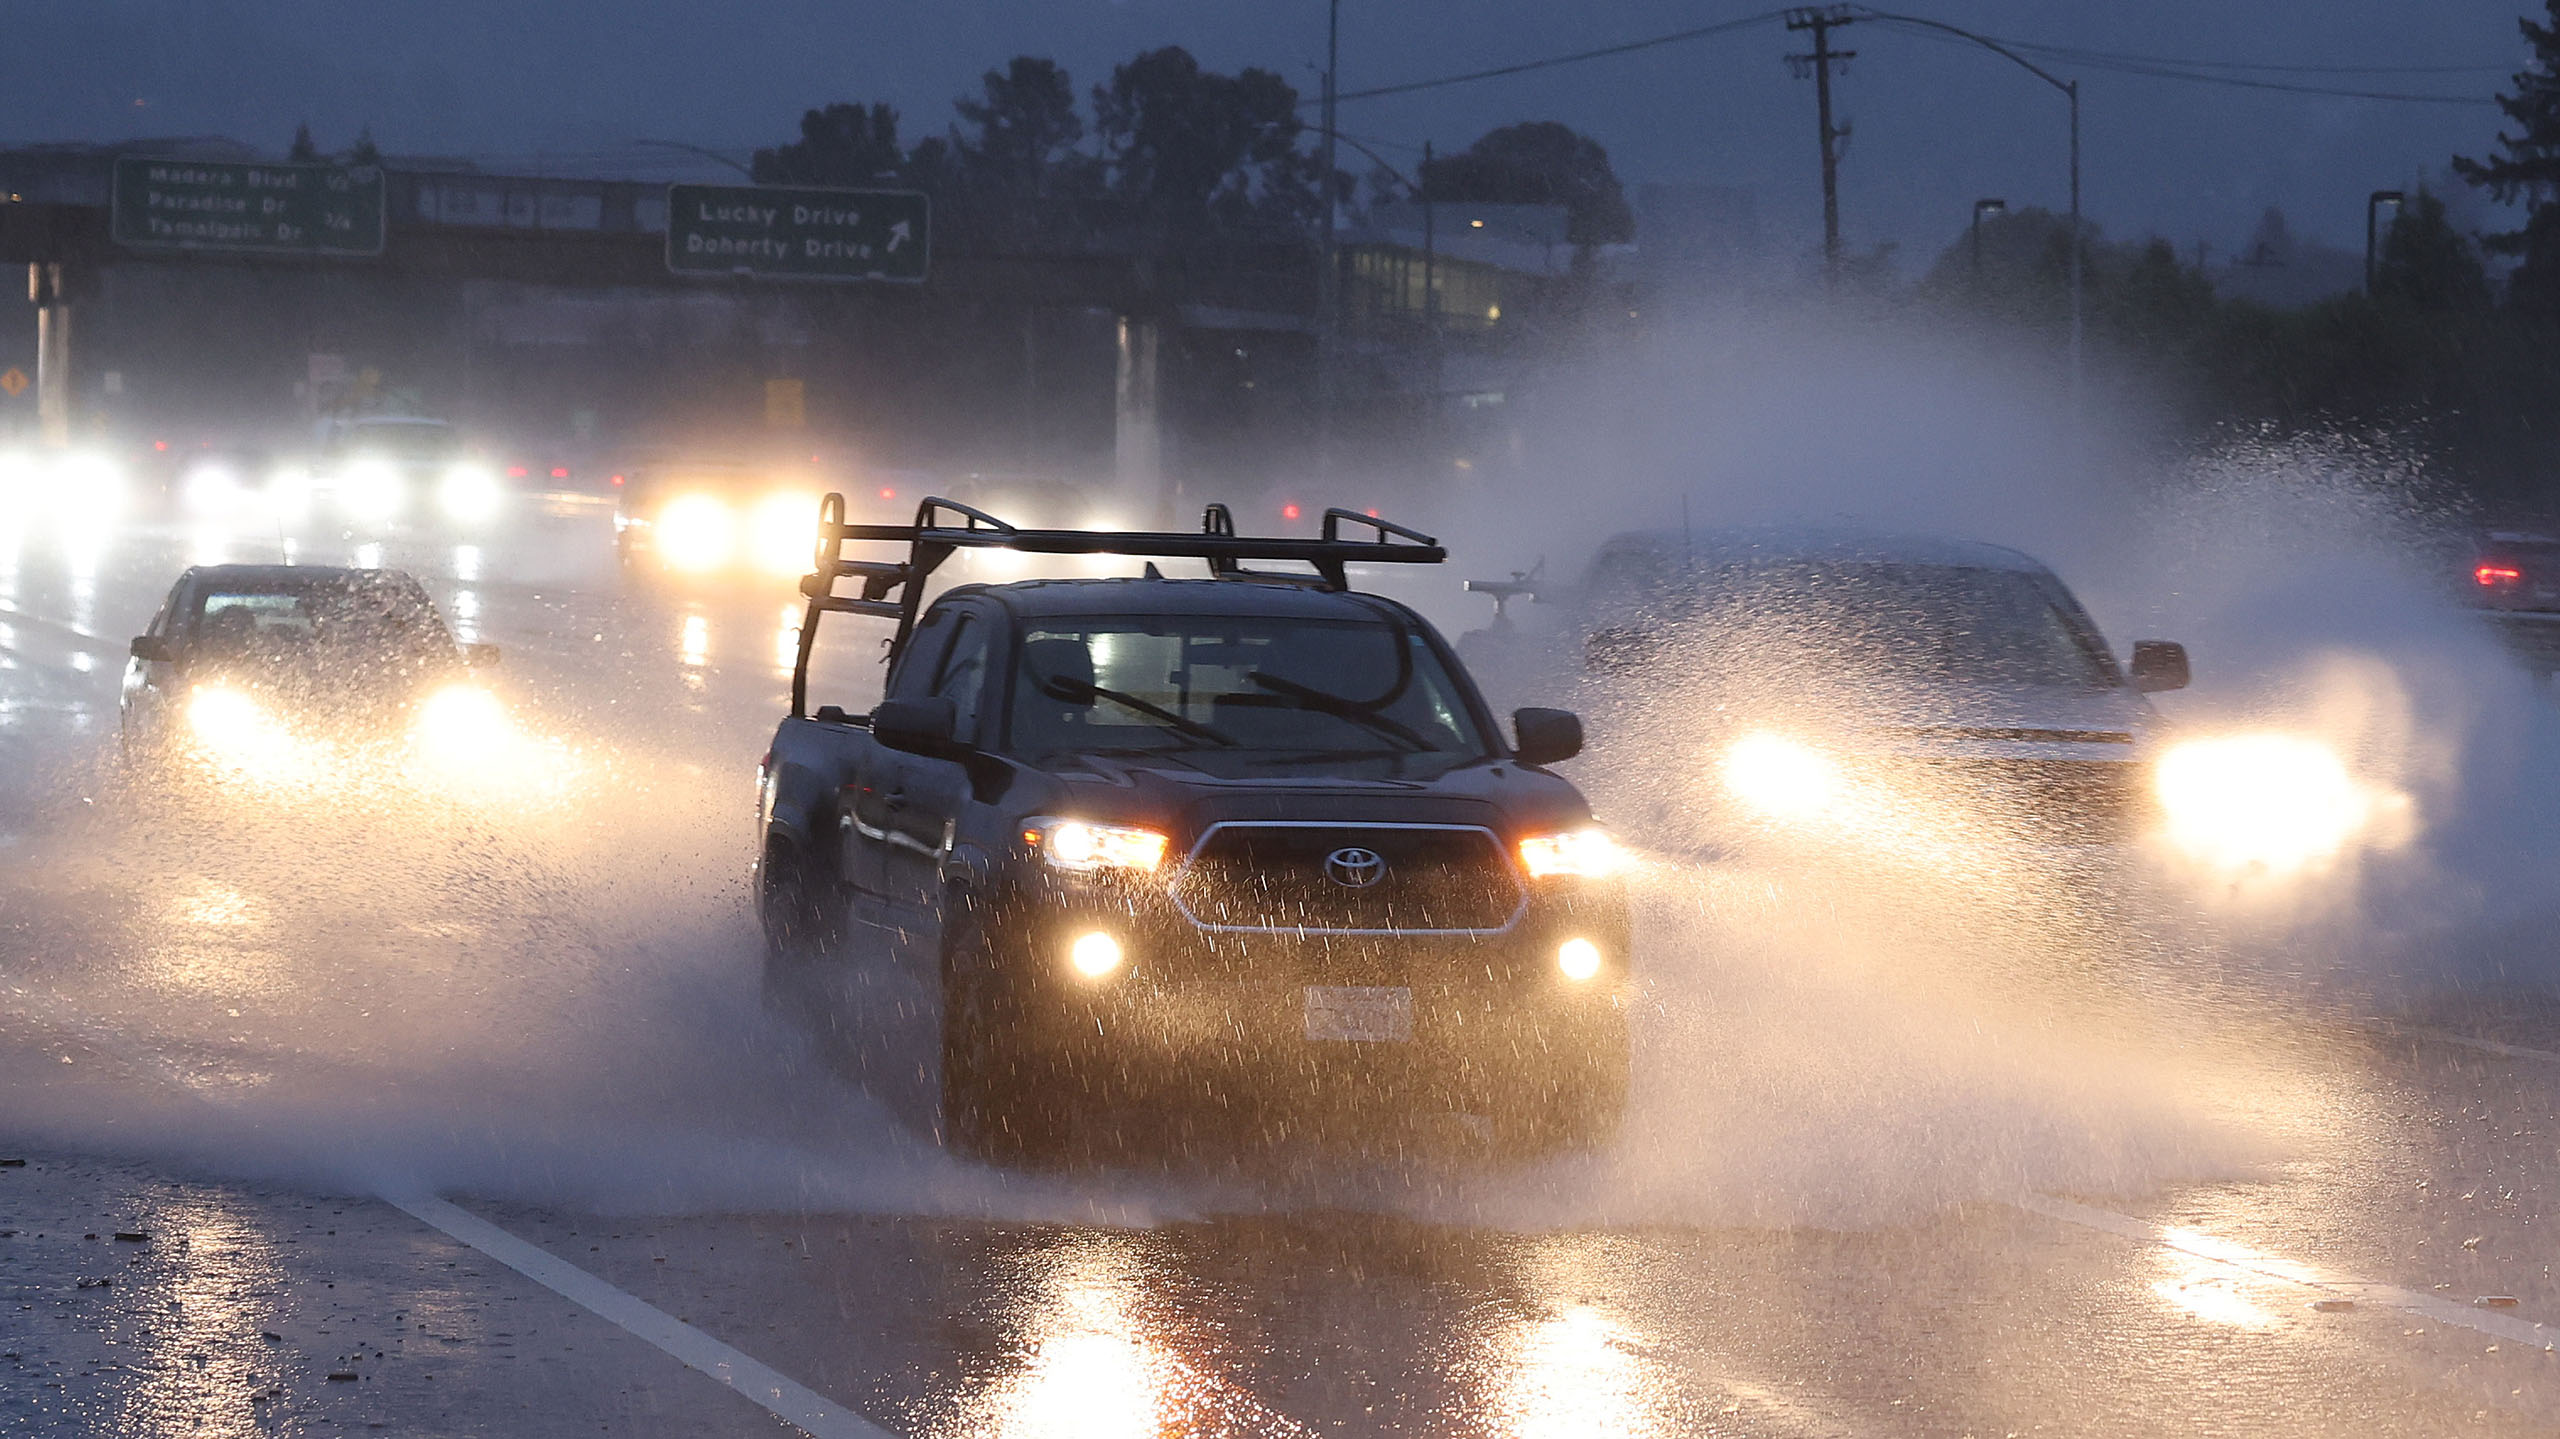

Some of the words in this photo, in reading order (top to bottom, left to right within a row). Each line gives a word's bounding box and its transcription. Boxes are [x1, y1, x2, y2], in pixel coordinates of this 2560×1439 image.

[149, 168, 232, 184] Madera
[248, 170, 296, 188] Blvd
[148, 191, 246, 212] Paradise
[263, 197, 287, 214] Dr
[700, 202, 776, 227] Lucky
[794, 205, 860, 226] Drive
[278, 222, 302, 241] Dr
[687, 233, 788, 259] Doherty
[805, 239, 872, 260] Drive
